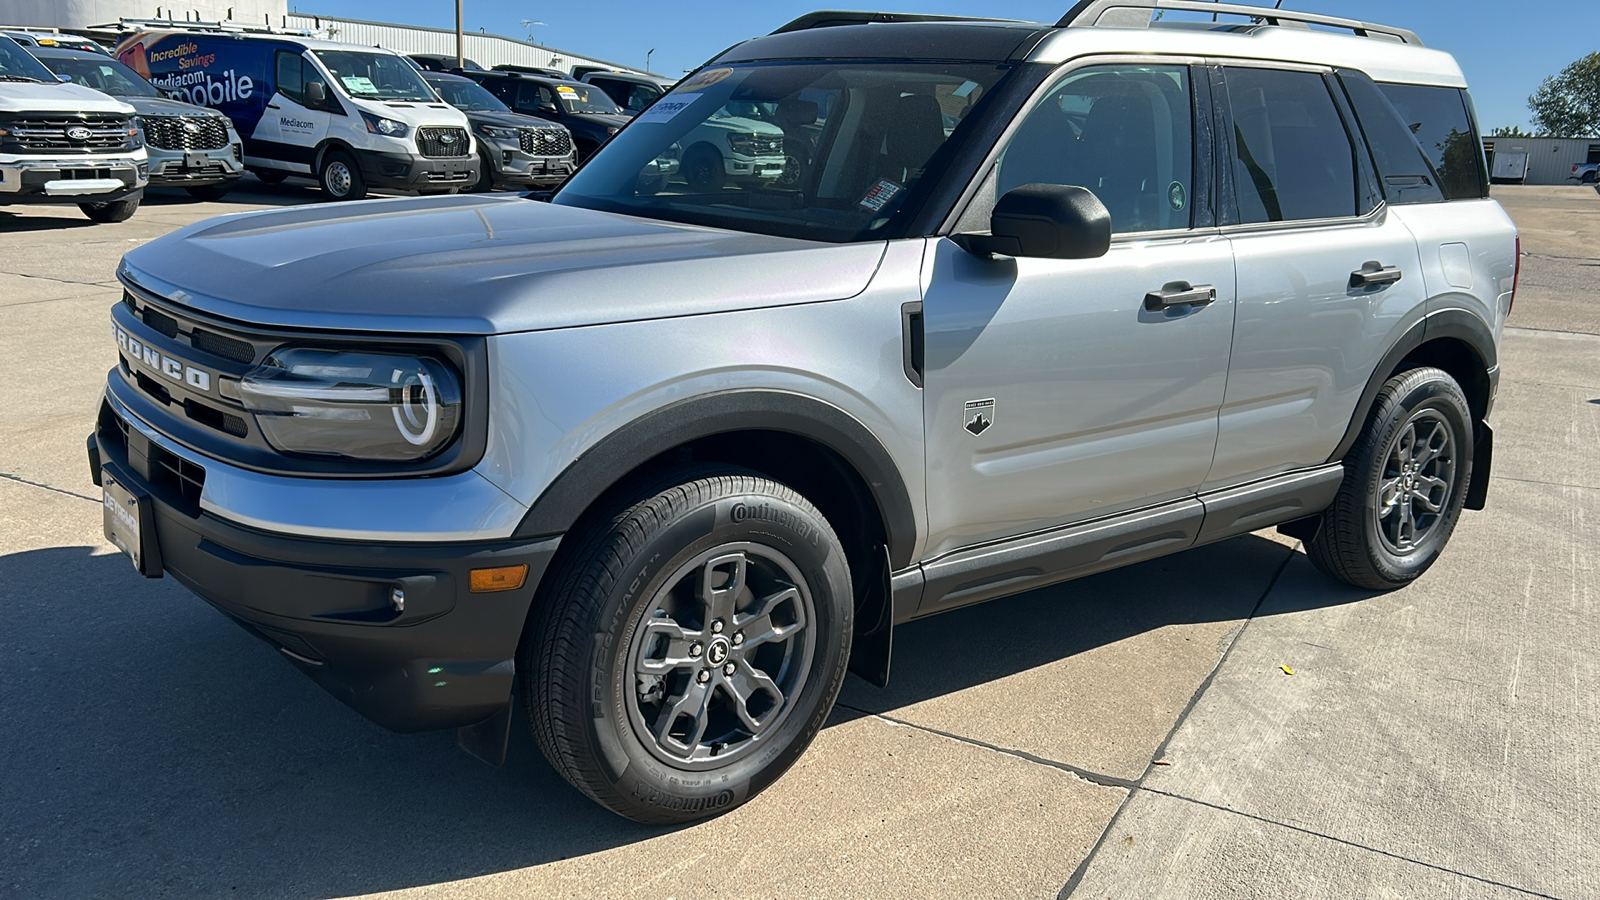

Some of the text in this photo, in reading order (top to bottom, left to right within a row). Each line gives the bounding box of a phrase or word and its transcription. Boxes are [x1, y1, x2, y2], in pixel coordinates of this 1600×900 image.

[150, 42, 198, 63] Incredible
[178, 53, 216, 70] Savings
[148, 70, 206, 88] Mediacom
[167, 69, 254, 107] mobile
[280, 117, 314, 129] Mediacom
[730, 502, 815, 540] Continental
[642, 786, 735, 813] Continental
